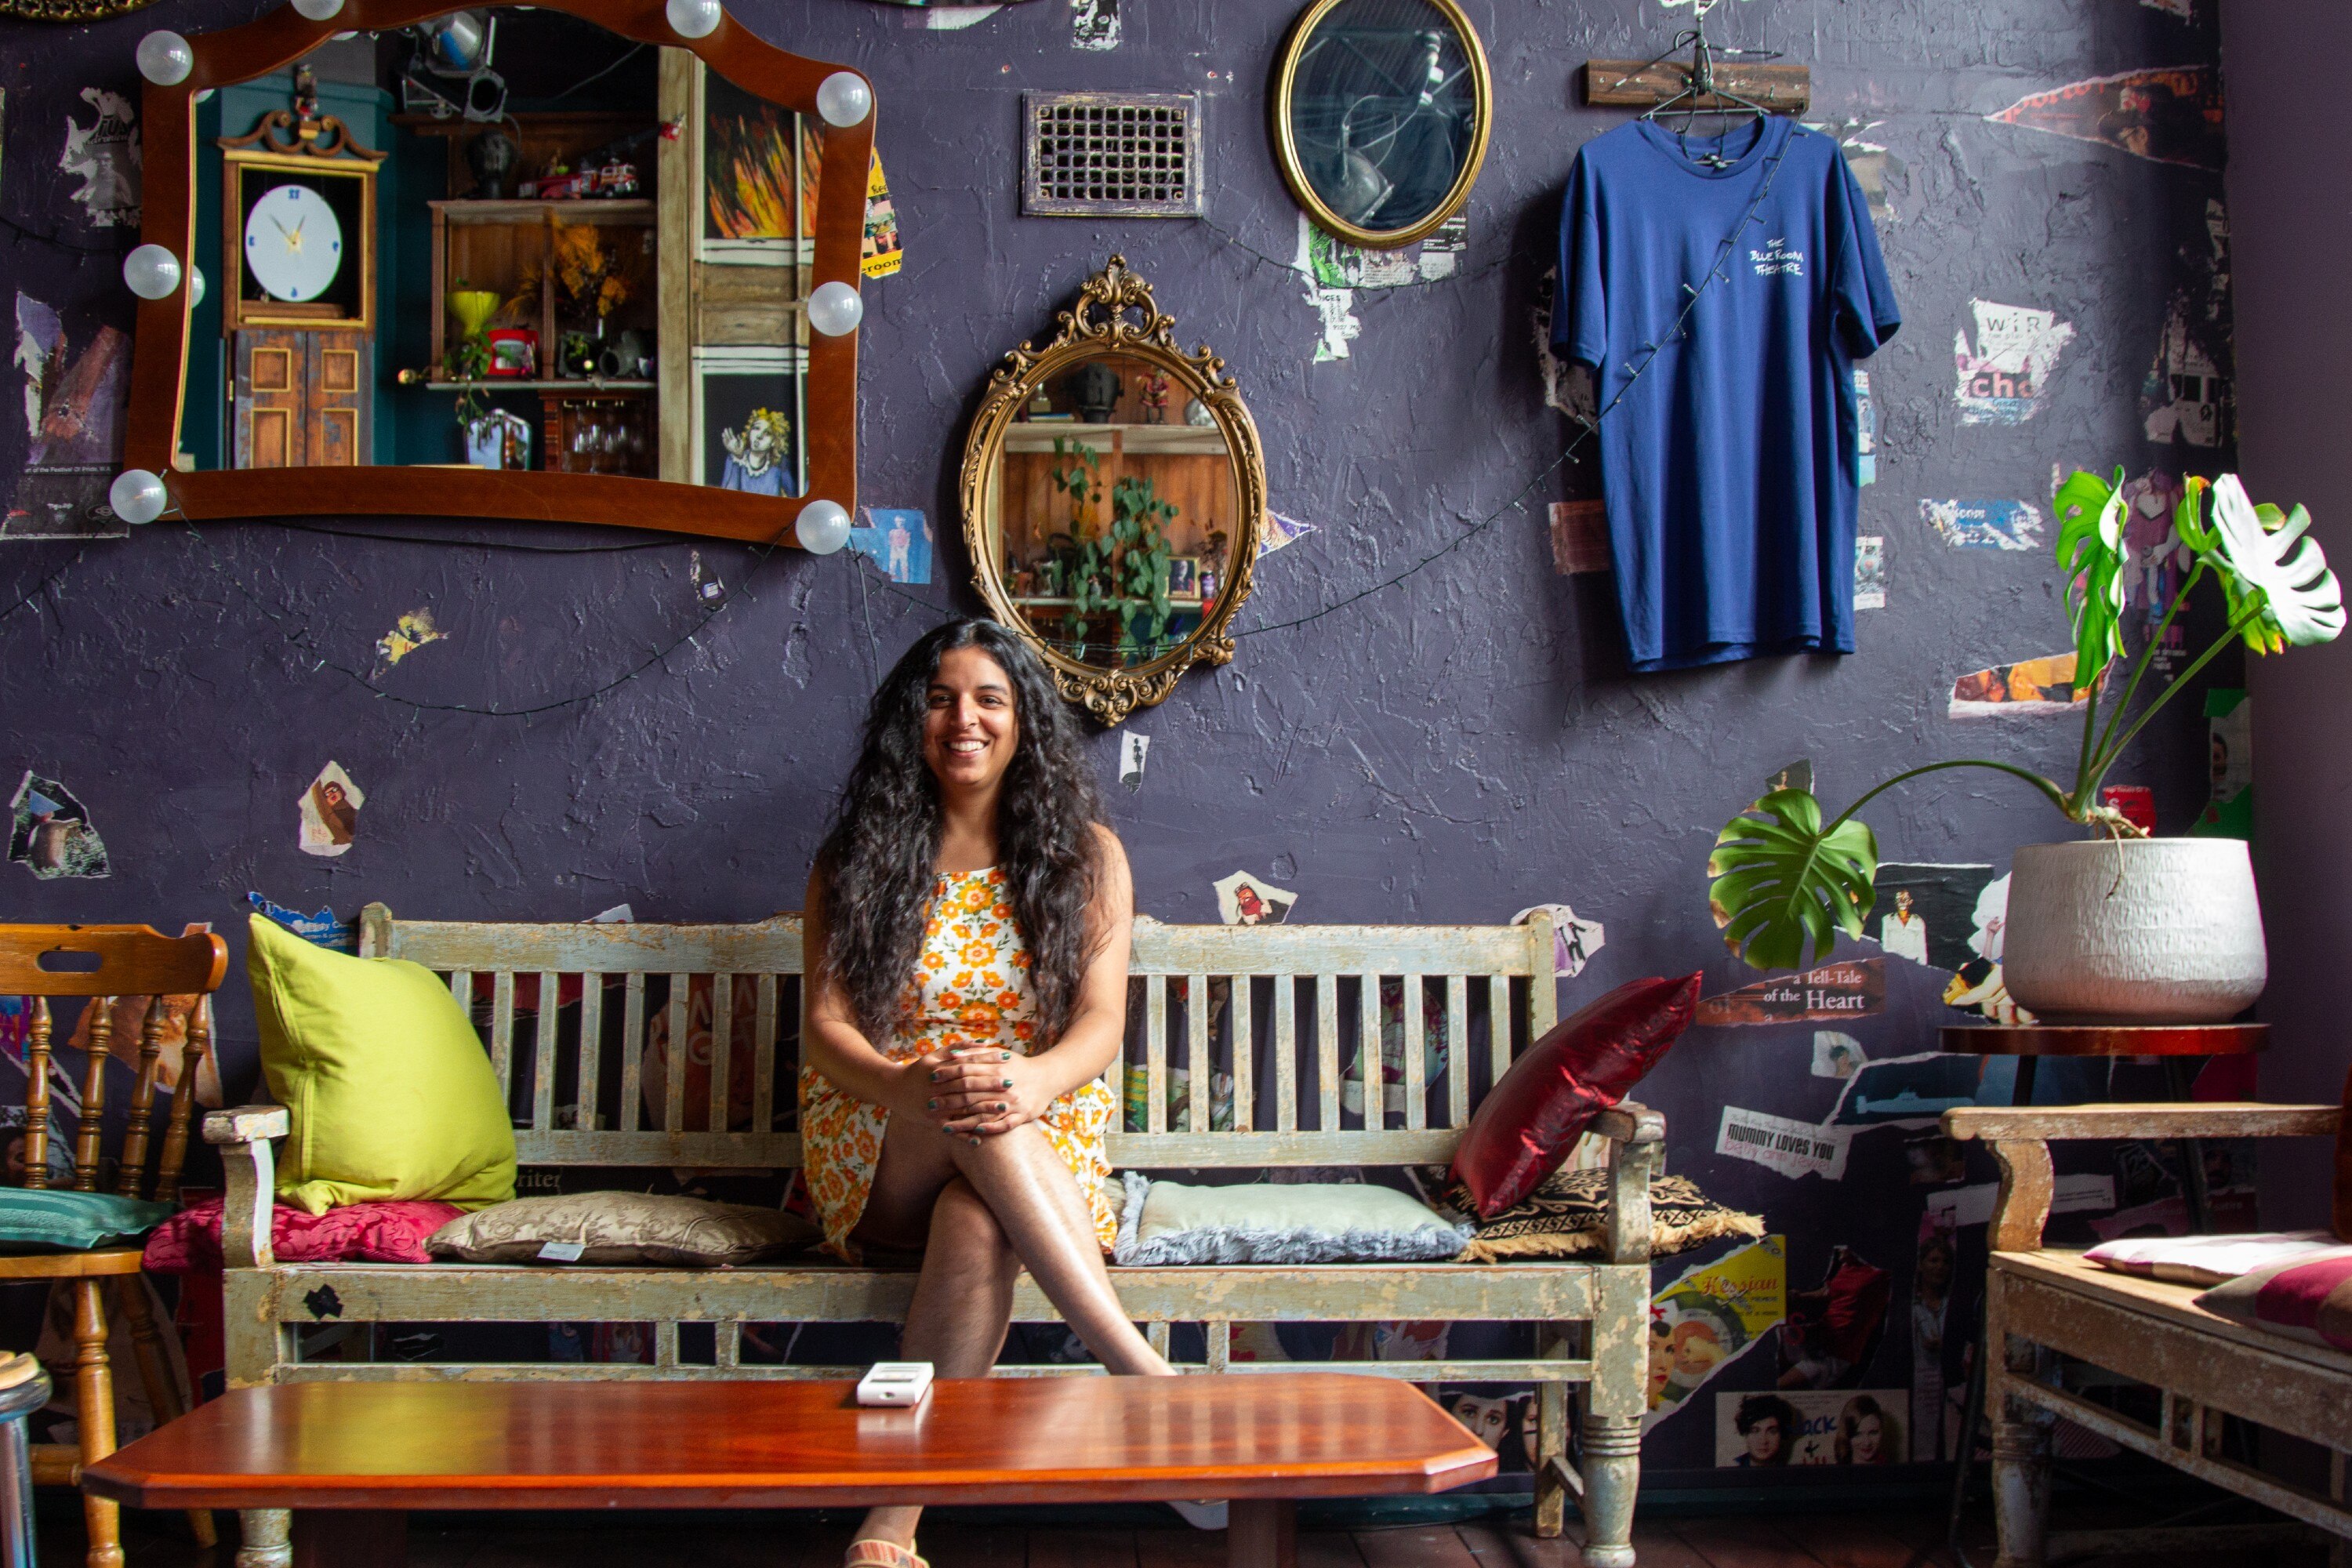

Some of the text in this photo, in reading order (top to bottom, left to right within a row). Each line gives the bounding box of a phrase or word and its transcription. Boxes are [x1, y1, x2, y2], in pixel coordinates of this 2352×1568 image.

[1766, 238, 1785, 249] THE
[1749, 249, 1804, 263] BLUE ROOM
[1754, 262, 1803, 277] THEATRE
[1792, 970, 1862, 985] a Tell-Tale
[1763, 988, 1865, 1010] of the Heart
[1812, 1141, 1835, 1161] YOU
